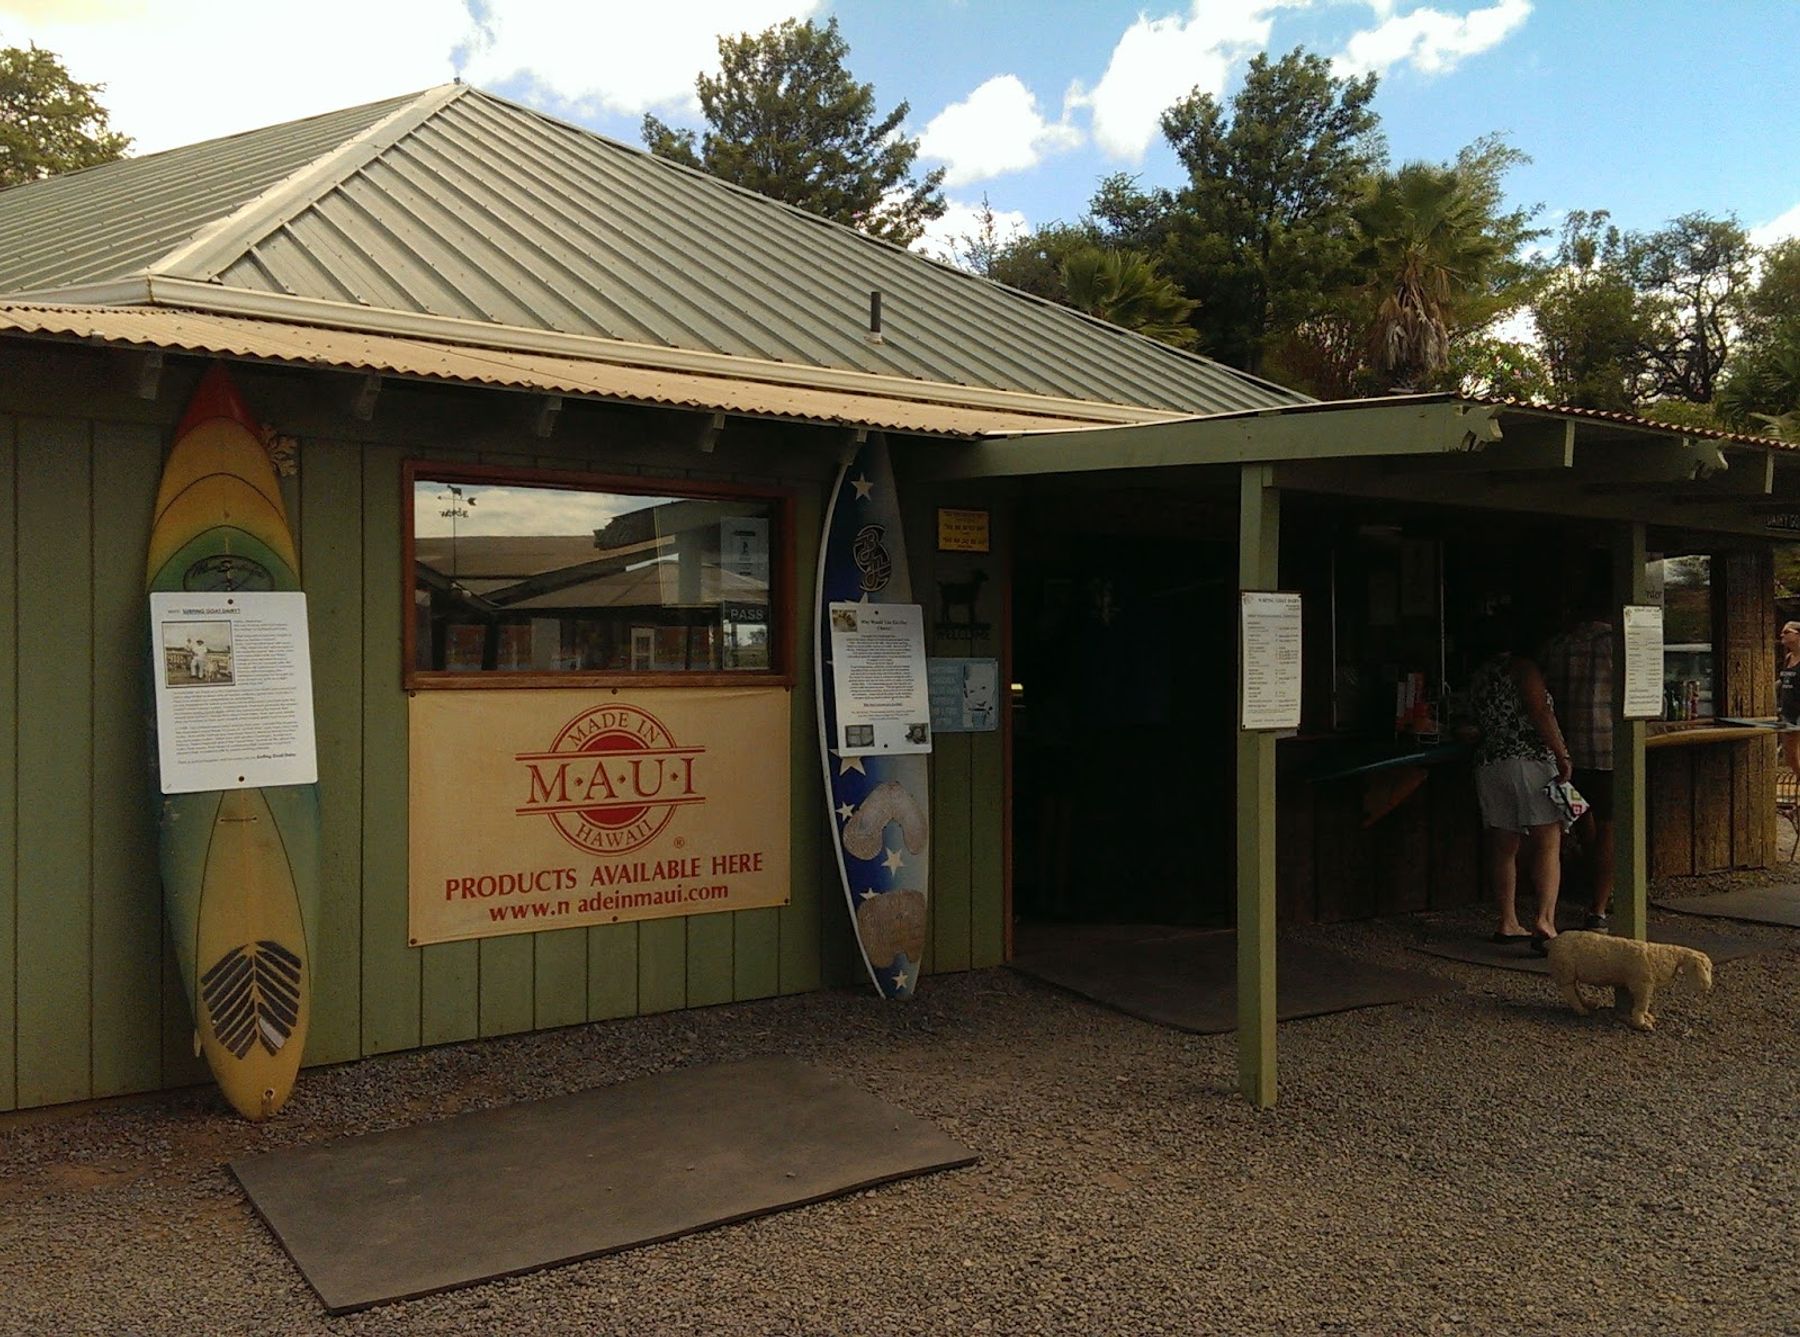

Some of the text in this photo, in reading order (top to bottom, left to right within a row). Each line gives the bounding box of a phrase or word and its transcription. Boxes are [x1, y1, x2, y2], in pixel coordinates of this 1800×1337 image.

[567, 711, 661, 748] MADE IN
[574, 818, 654, 848] HAWAII
[445, 851, 764, 901] PRODUCTS AVAILABLE HERE
